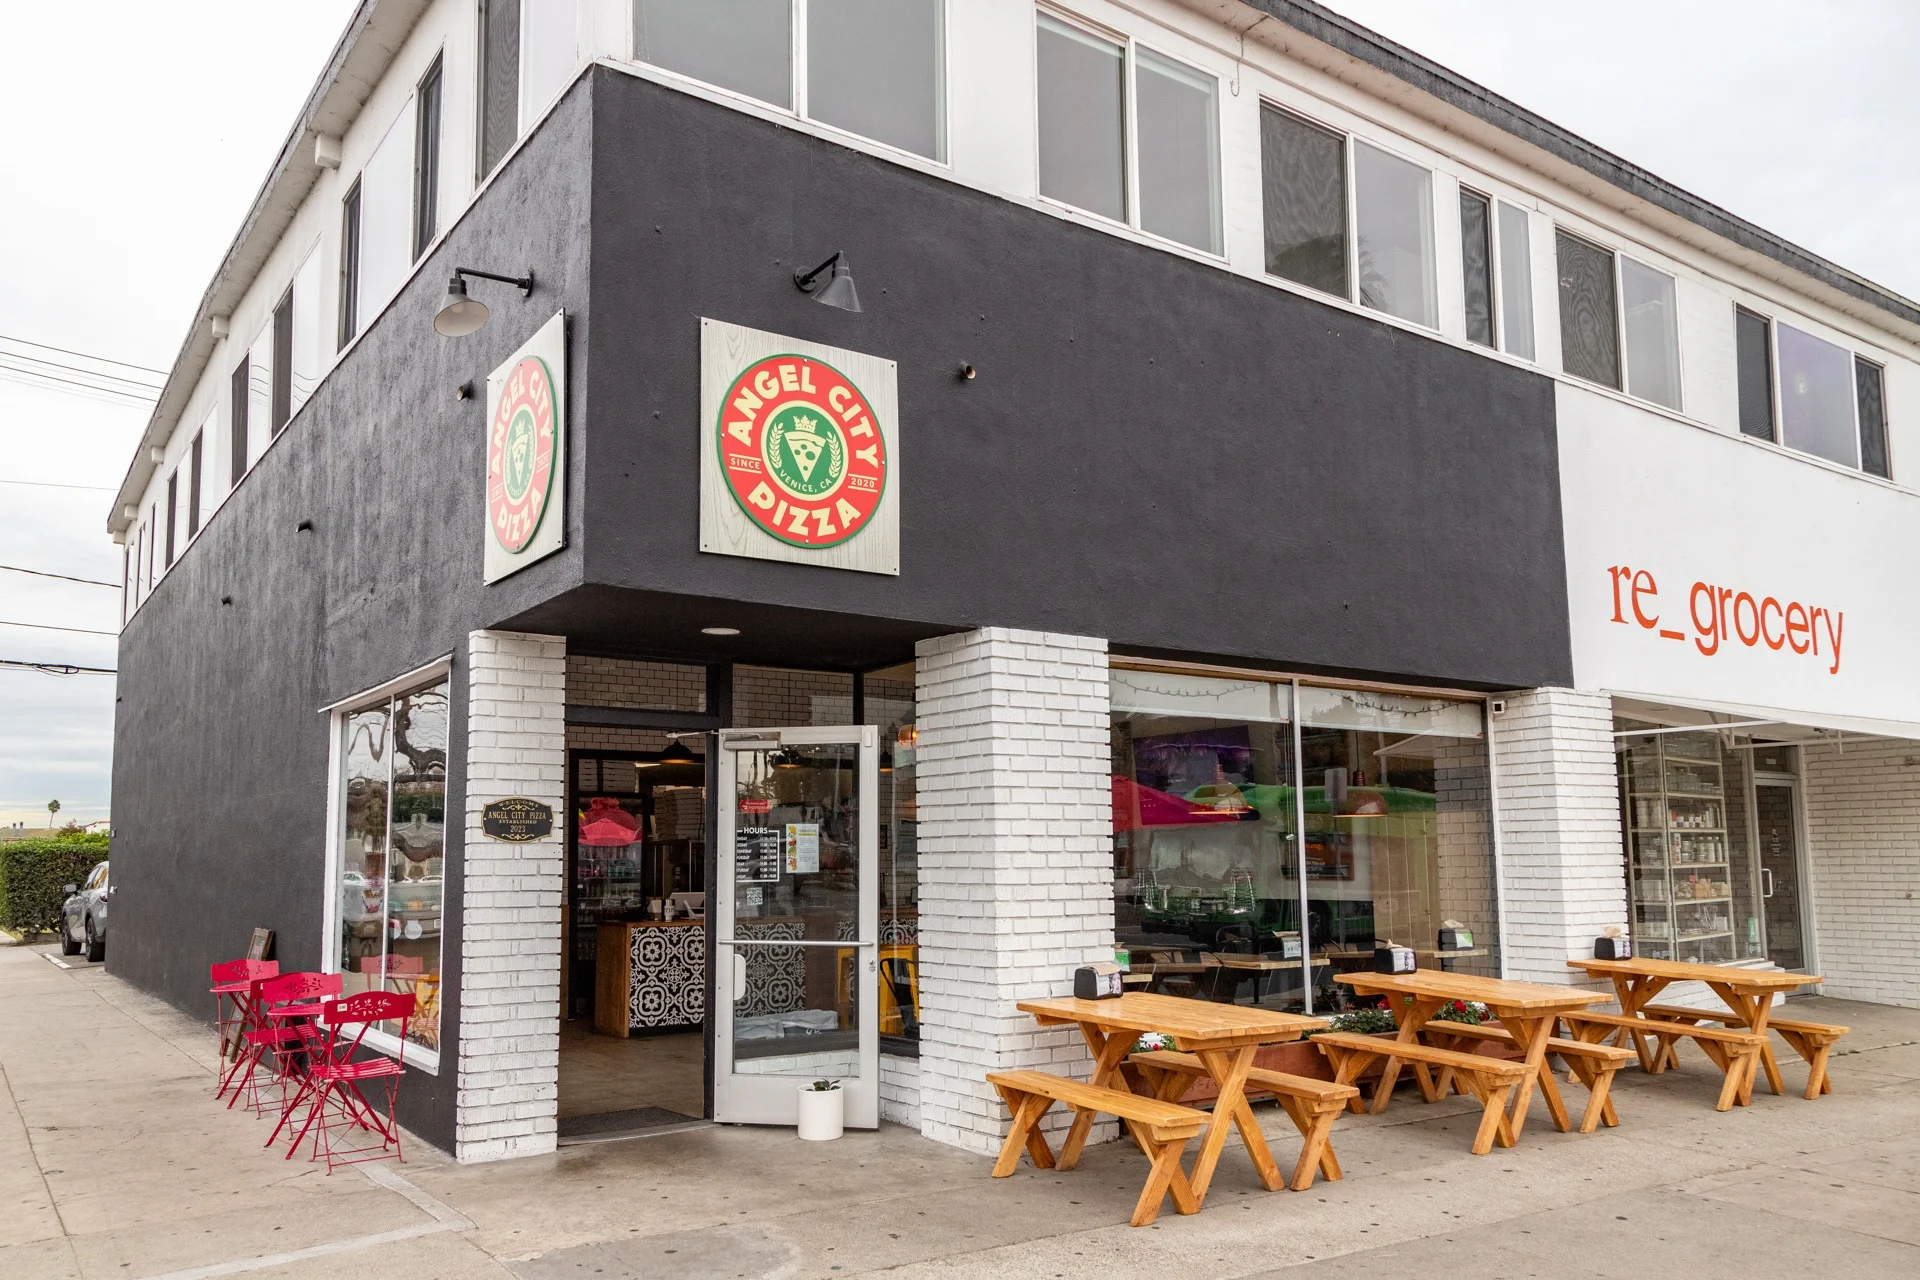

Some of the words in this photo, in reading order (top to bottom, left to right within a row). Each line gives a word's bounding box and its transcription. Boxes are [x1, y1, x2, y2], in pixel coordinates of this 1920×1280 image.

[491, 369, 526, 475] ANGEL
[529, 370, 551, 438] CITY
[728, 364, 816, 447] ANGEL
[828, 385, 879, 469] CITY
[730, 458, 761, 470] SINCE
[851, 477, 875, 489] 2020
[780, 469, 818, 493] VENICE,
[820, 478, 832, 490] CA
[497, 487, 542, 542] PIZZA
[747, 481, 862, 537] PIZZA
[1607, 566, 1844, 675] re_grocery
[488, 811, 508, 819] ANGEL
[511, 811, 526, 819] CITY
[529, 812, 547, 820] PIZZA
[510, 825, 526, 833] 2023
